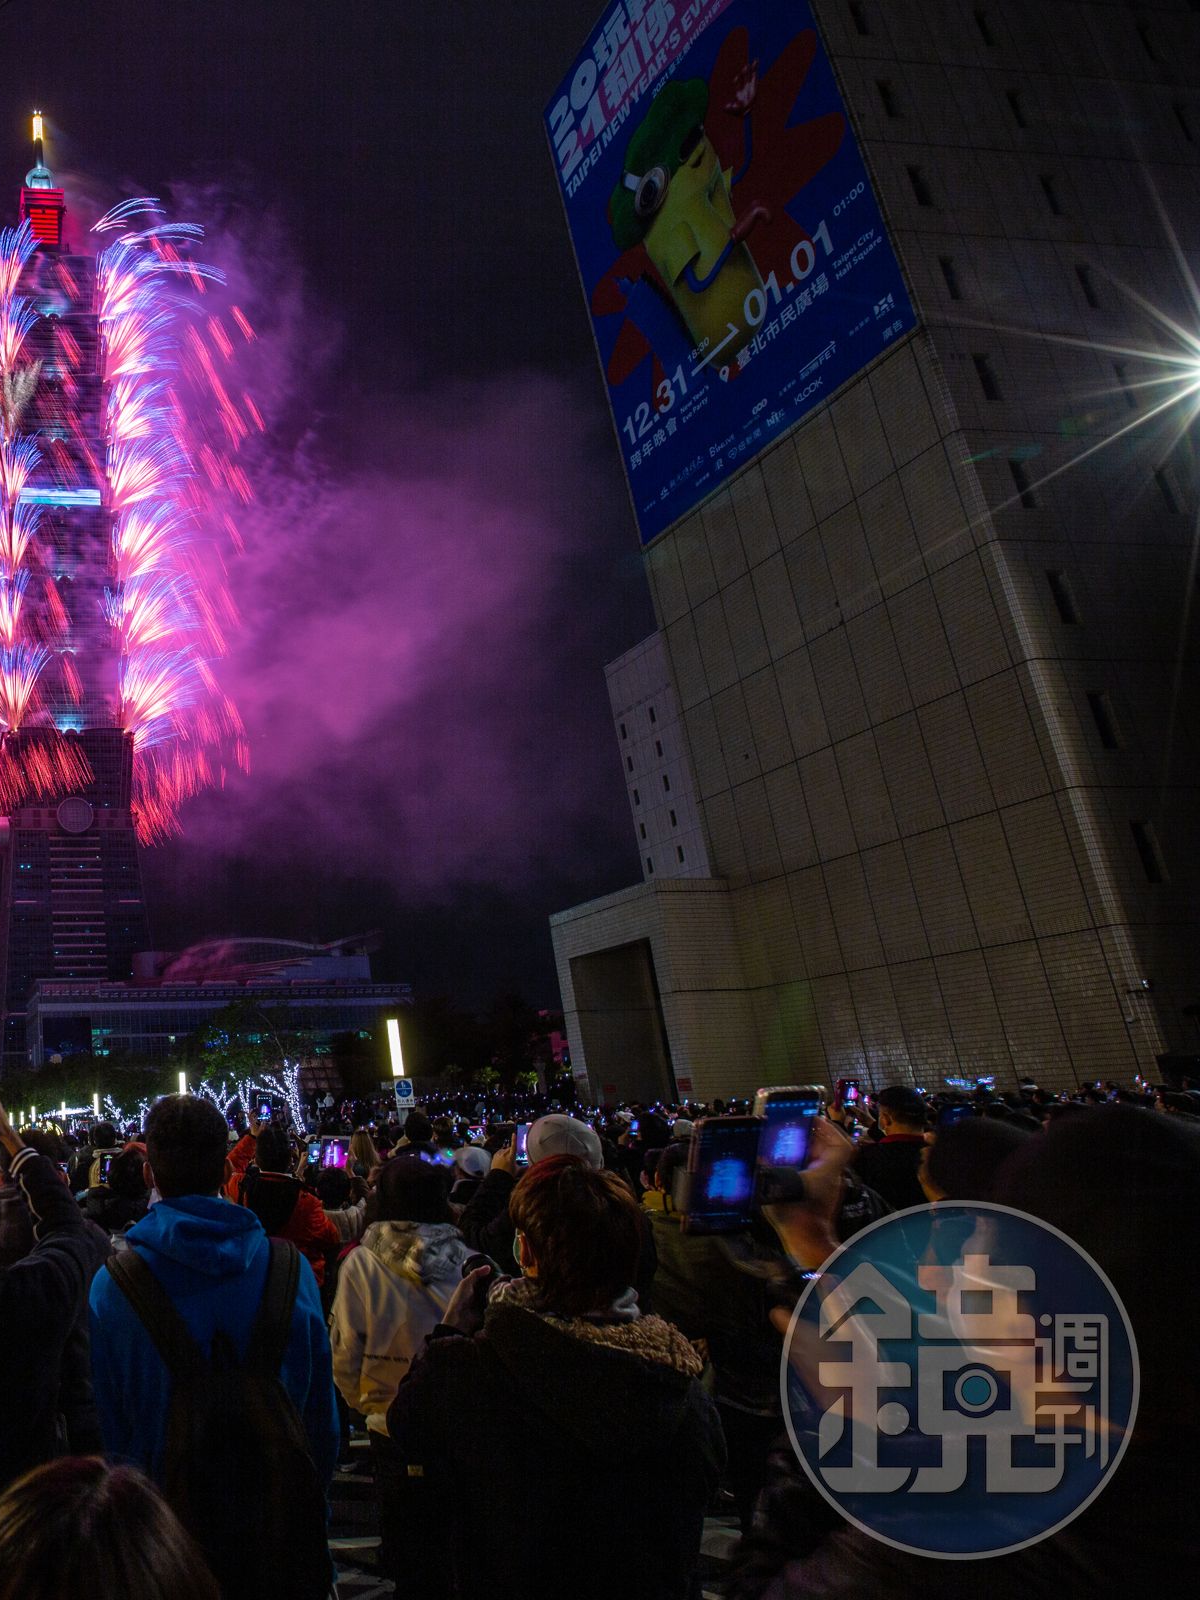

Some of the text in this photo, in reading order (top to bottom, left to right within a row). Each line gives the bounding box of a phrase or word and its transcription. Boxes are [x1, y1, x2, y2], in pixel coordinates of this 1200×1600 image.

[566, 0, 709, 199] TAIPEI NEW YEAR'S EV
[833, 228, 875, 269] Taipei City
[835, 237, 882, 281] Hall Square
[623, 365, 688, 445] 12.31
[687, 337, 710, 363] 18:30
[743, 220, 834, 327] 01.01
[833, 181, 865, 217] 01:00
[735, 271, 830, 370] 臺北市民廣場
[794, 376, 824, 405] KLOOK
[630, 416, 678, 471] 跨年晚會
